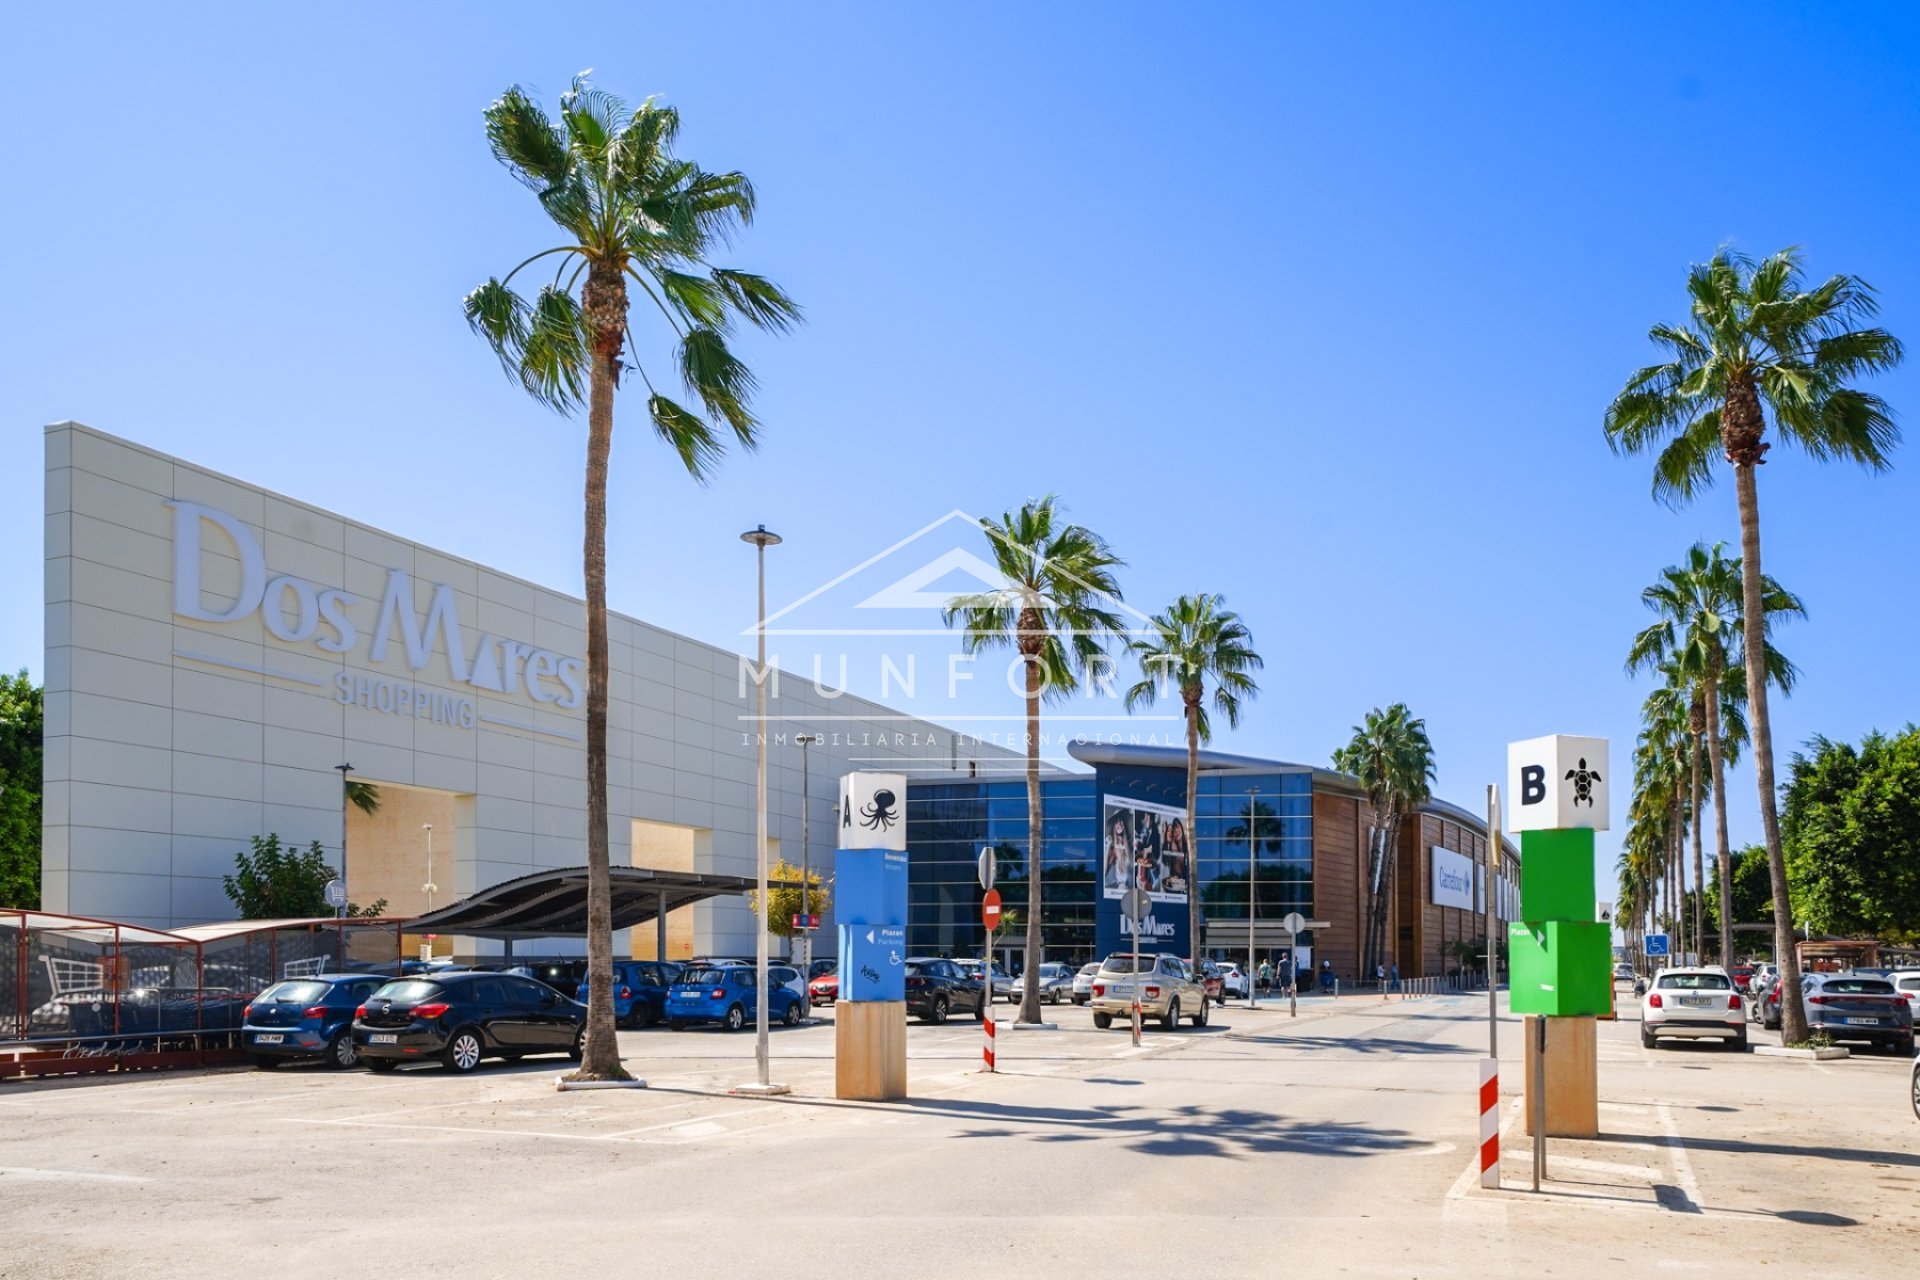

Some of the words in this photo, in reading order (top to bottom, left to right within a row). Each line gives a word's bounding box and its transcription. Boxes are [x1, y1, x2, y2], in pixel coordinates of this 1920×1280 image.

[163, 499, 359, 654] Dos
[333, 671, 475, 730] SHOPPING
[1520, 764, 1547, 806] B
[843, 794, 852, 829] A
